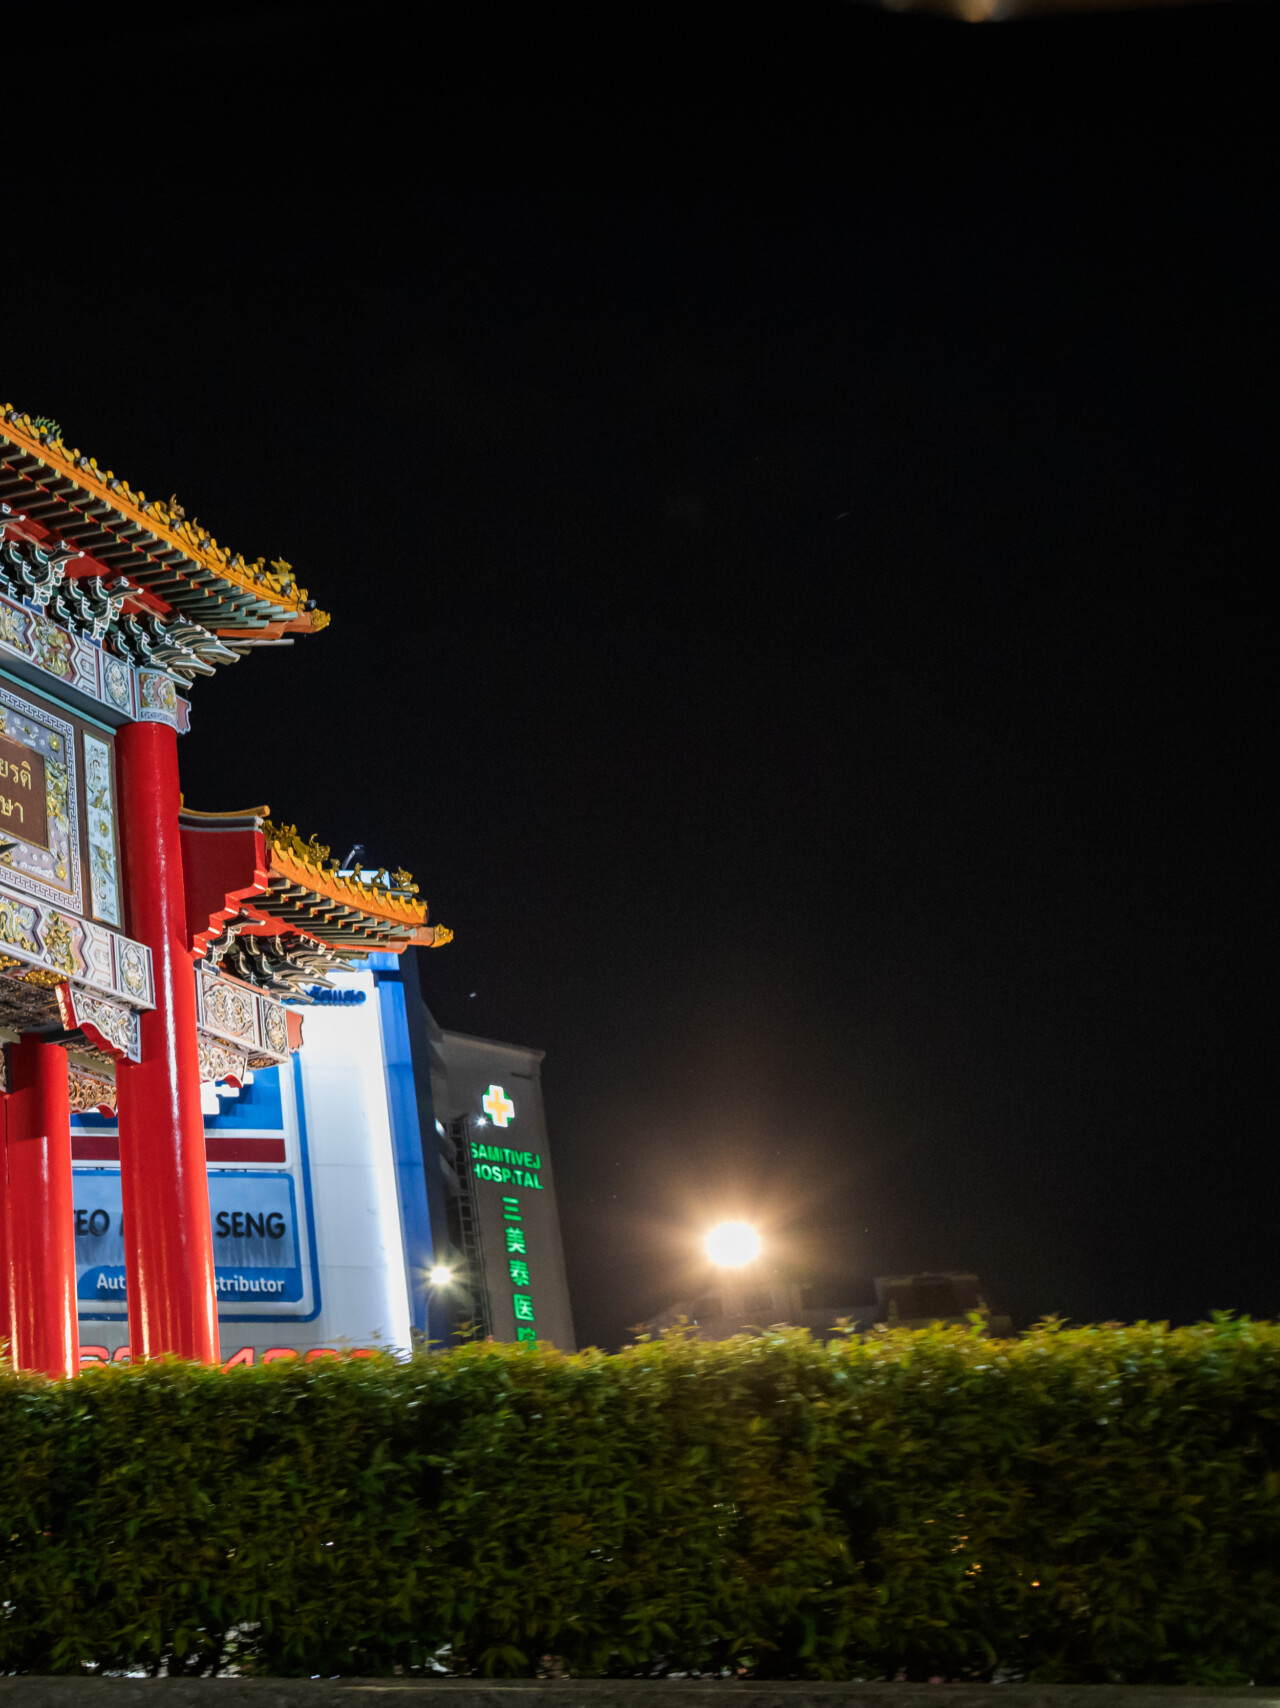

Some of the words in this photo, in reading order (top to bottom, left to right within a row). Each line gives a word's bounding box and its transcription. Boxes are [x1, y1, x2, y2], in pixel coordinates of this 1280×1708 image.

[470, 1141, 541, 1169] SAMITIVEJ
[74, 1208, 110, 1237] EO
[216, 1211, 286, 1239] SENG
